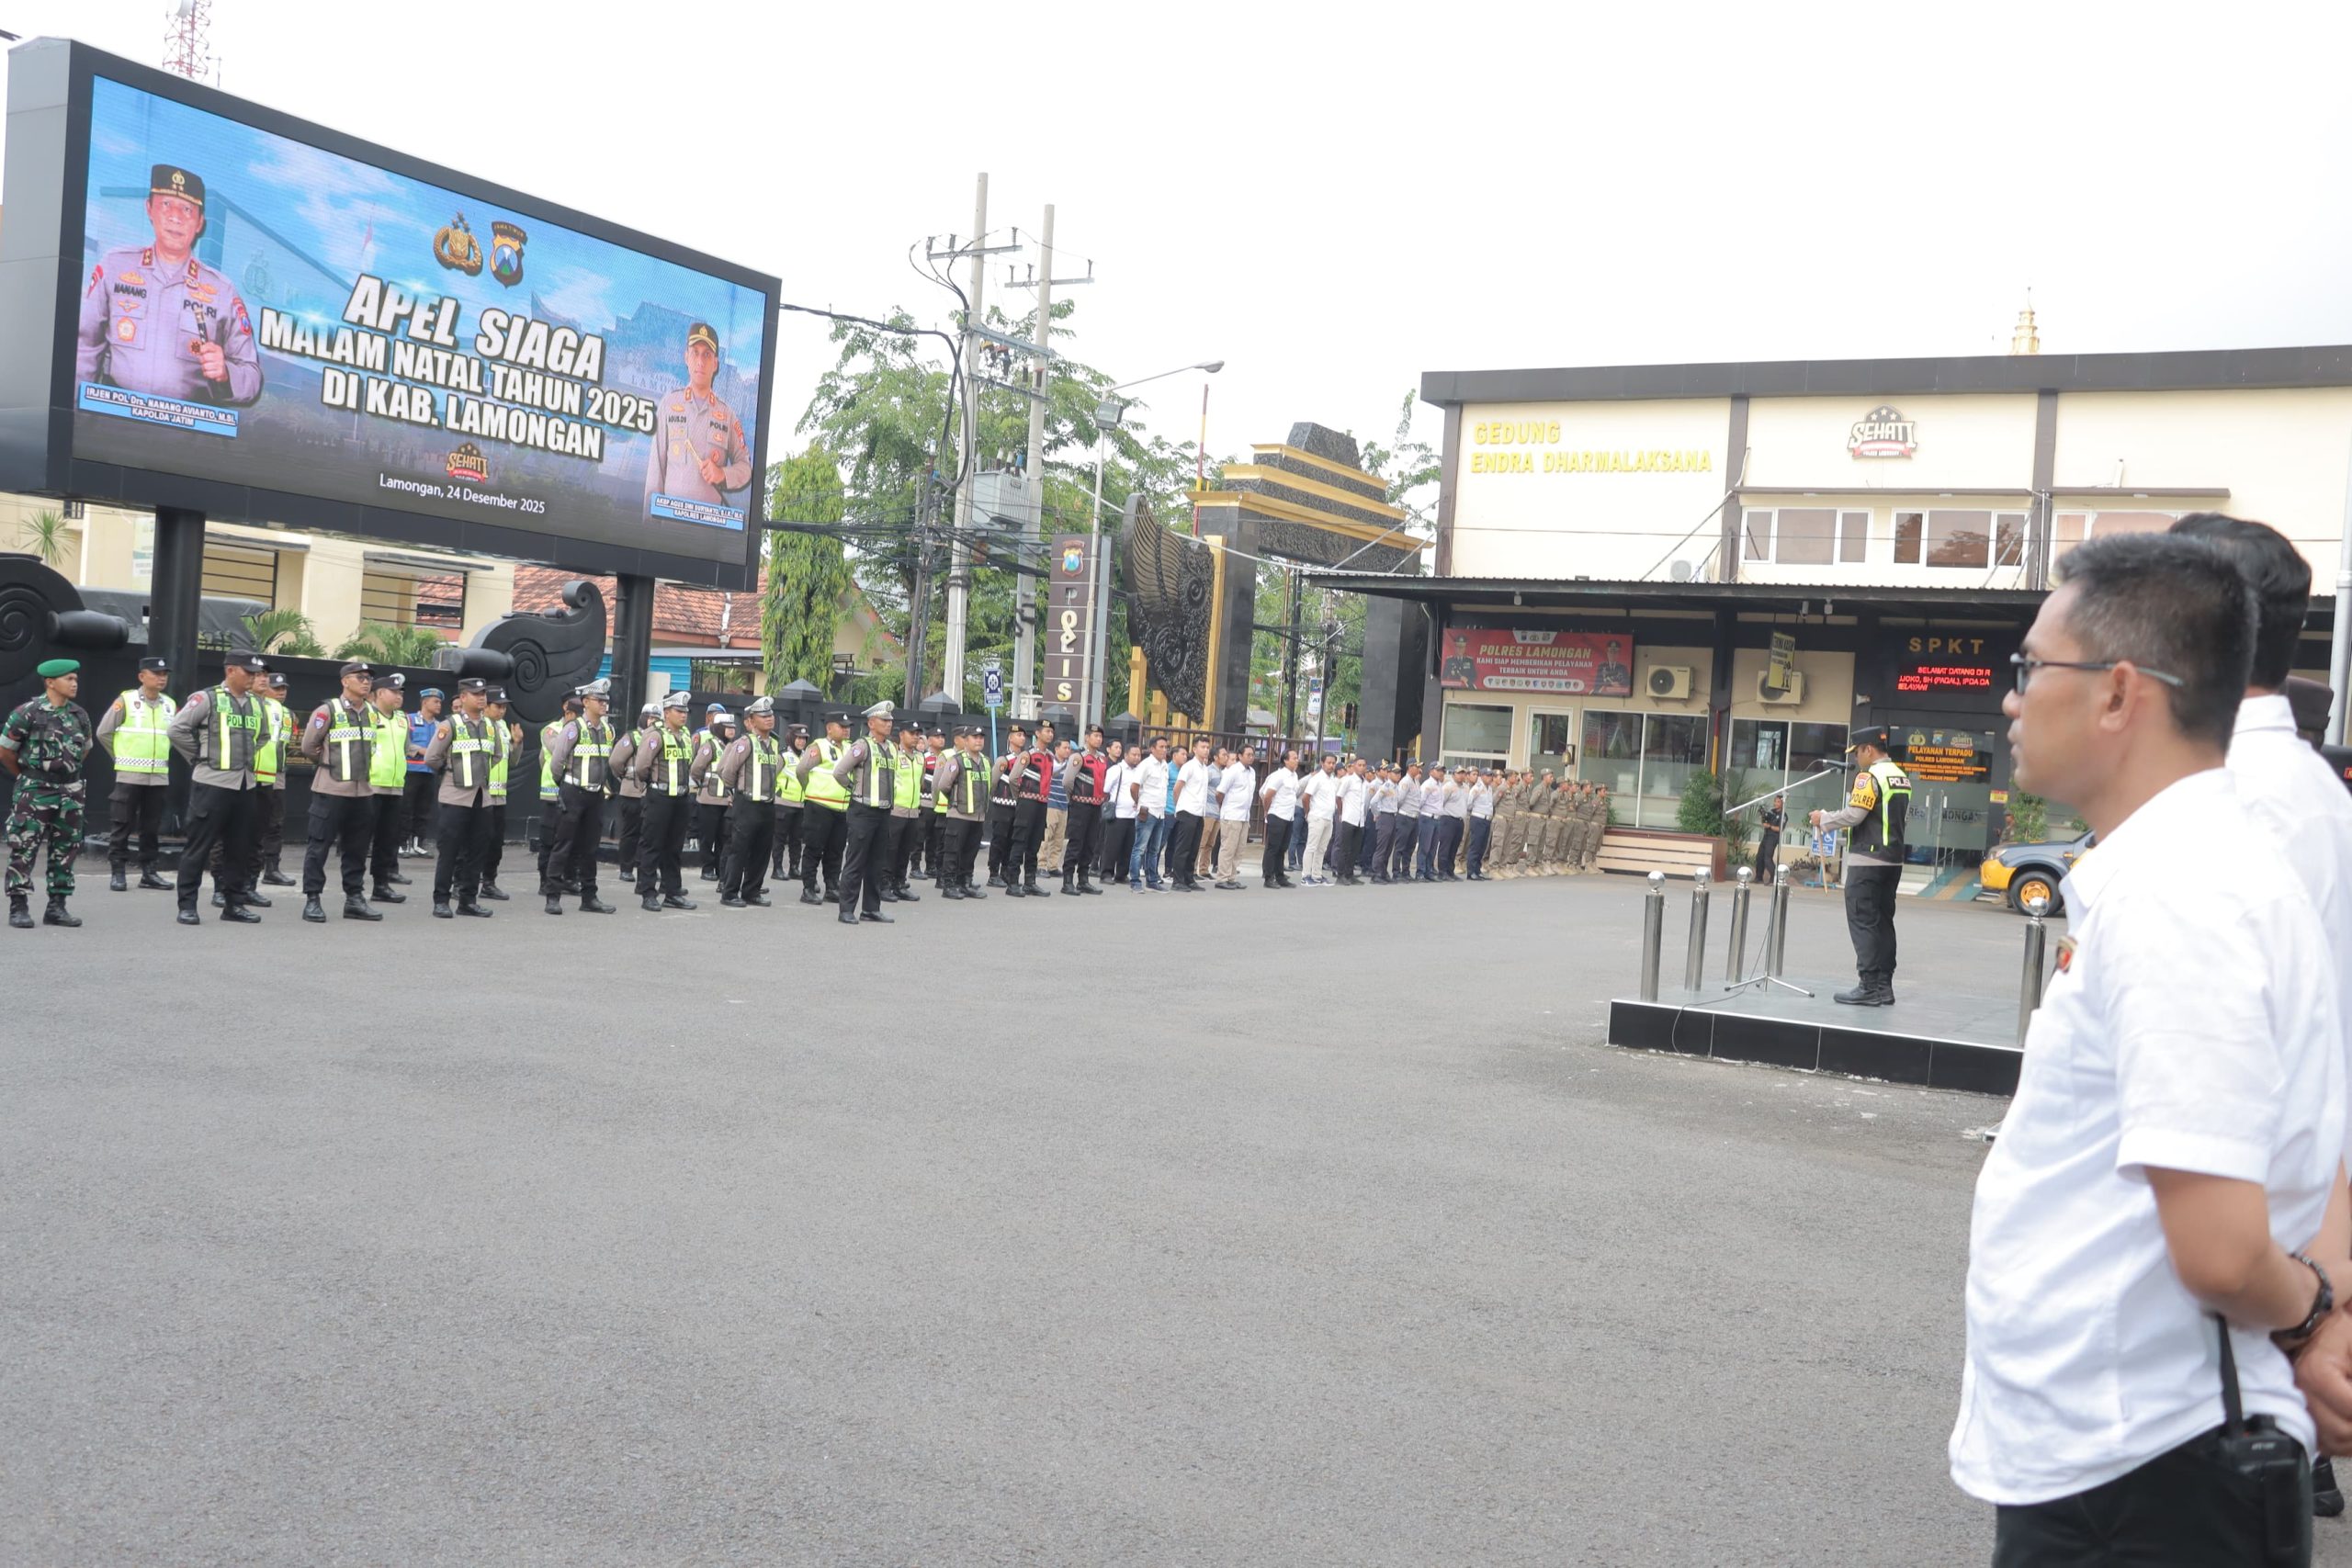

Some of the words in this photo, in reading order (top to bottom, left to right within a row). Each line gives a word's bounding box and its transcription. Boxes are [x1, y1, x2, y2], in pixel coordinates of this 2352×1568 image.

[114, 283, 147, 299] NANANG
[342, 274, 458, 346] APEL
[476, 308, 603, 381] SIAGA
[260, 308, 387, 372] MALAM
[392, 339, 483, 393] NATAL
[491, 364, 581, 414] TAHUN
[586, 387, 655, 432] 2025
[86, 387, 111, 400] IRJEN
[112, 391, 129, 403] POL
[130, 395, 146, 406] Drs.
[148, 399, 182, 412] NANANG
[183, 406, 217, 420] AVIANTO,
[322, 367, 358, 409] DI
[366, 377, 439, 425] KAB.
[446, 395, 602, 458] LAMONGAN
[131, 408, 170, 422] KAPOLDA
[171, 414, 195, 426] JATIM
[1474, 422, 1560, 445] GEDUNG
[1847, 421, 1917, 449] SEHATI
[446, 453, 489, 478] SEHATI
[1471, 452, 1533, 473] ENDRA
[1544, 450, 1712, 472] DHARMALAKSANA
[379, 473, 444, 498] Lamongan,
[447, 485, 460, 499] 24
[463, 489, 517, 509] Desember
[520, 499, 545, 513] 2025
[1479, 645, 1522, 657] POLRES
[1526, 646, 1592, 659] LAMONGAN
[1909, 637, 1984, 654] SPKT
[1499, 667, 1526, 675] TERBAIK
[1554, 660, 1593, 668] PELAYANAN
[1917, 666, 1948, 675] SELAMAT
[1908, 746, 1944, 756] PELAYANAN
[1944, 748, 1973, 757] TERPADU
[1851, 794, 1874, 807] POLRES
